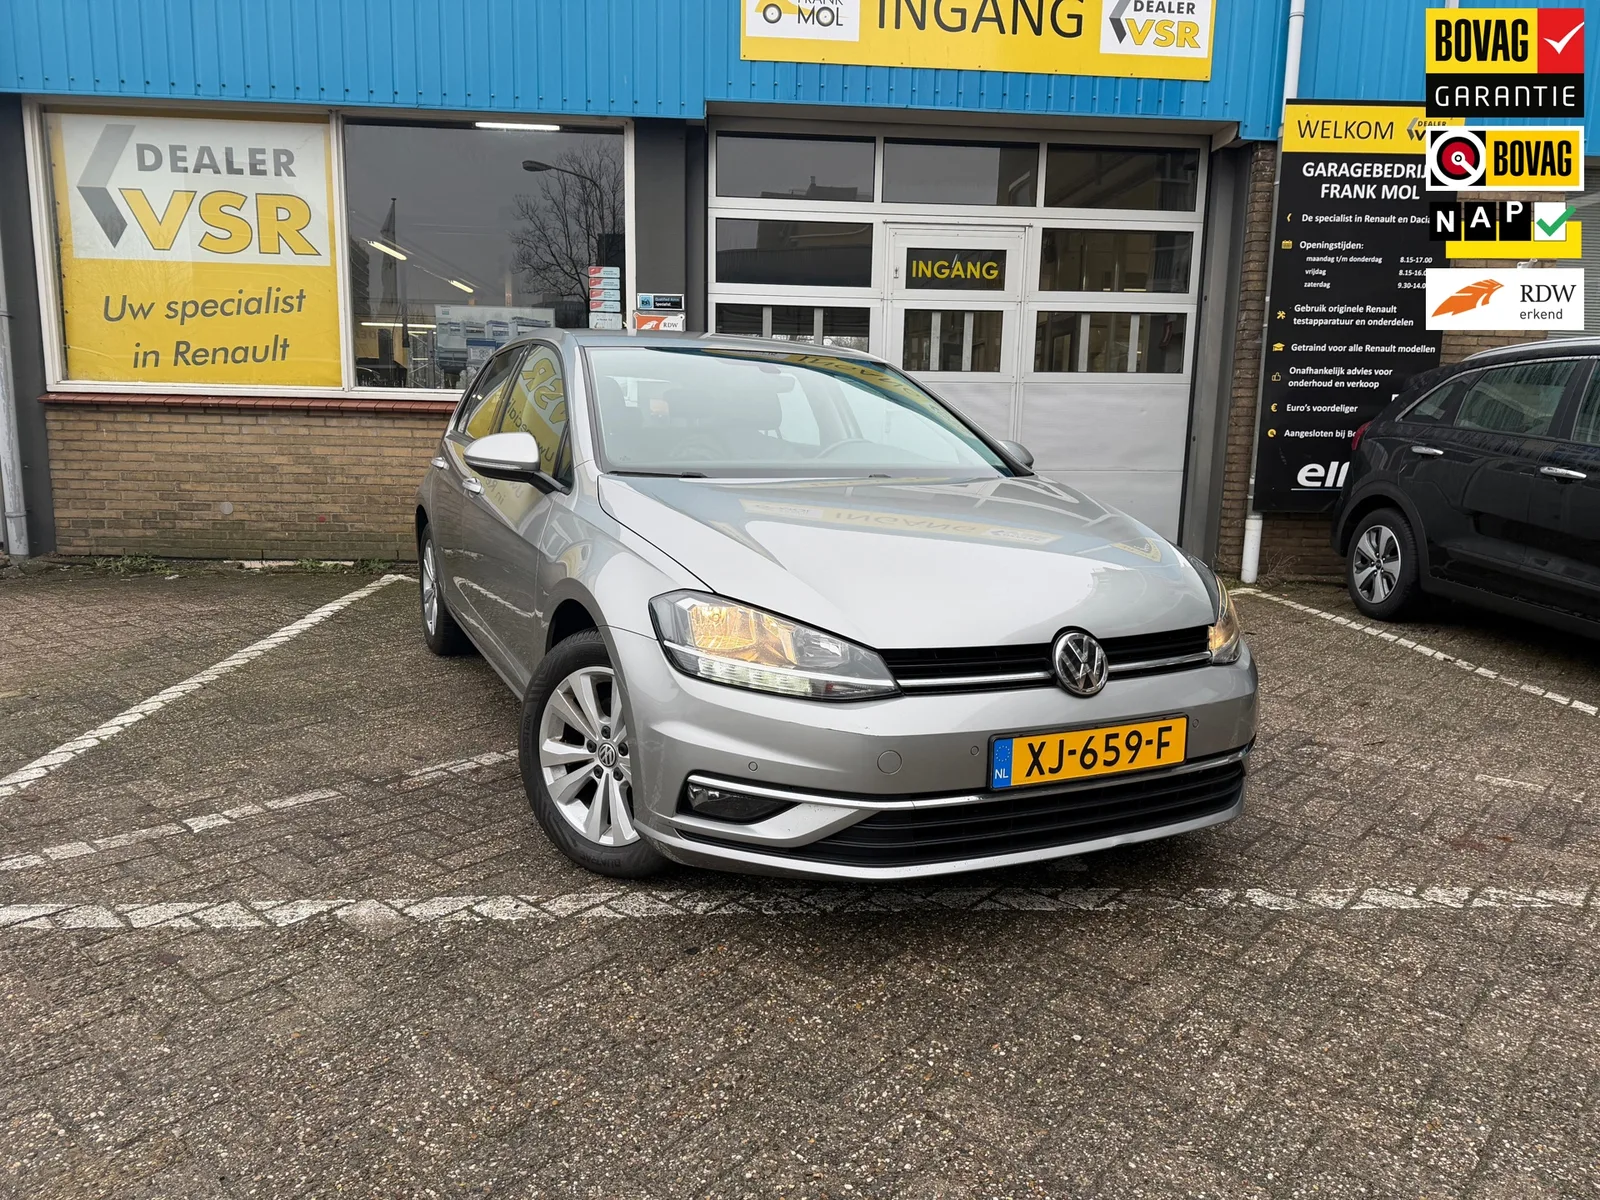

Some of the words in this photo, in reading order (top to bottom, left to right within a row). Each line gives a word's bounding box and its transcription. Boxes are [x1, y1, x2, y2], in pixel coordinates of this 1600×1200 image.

[1133, 0, 1196, 15] DEALER
[798, 5, 844, 27] MOL
[878, 0, 1084, 38] INGANG
[1124, 17, 1201, 48] VSR
[1297, 120, 1395, 141] WELKOM
[136, 143, 297, 178] DEALER
[1302, 162, 1426, 179] GARAGEBEDRIJ
[1320, 184, 1377, 200] FRANK
[1381, 185, 1420, 200] MOL
[118, 187, 322, 256] VSR
[1302, 214, 1313, 223] De
[1315, 214, 1353, 224] specialist
[1354, 215, 1363, 224] in
[1364, 214, 1396, 224] Renault
[1398, 216, 1408, 224] en
[1300, 240, 1364, 251] Openingstijden:
[1306, 255, 1334, 264] maandag
[1336, 255, 1348, 263] t/m
[1349, 255, 1383, 264] donderdag
[1400, 256, 1433, 264] 8.15-17.00
[912, 260, 999, 279] INGANG
[1305, 268, 1327, 277] vrijdag
[1304, 280, 1331, 289] zaterdag
[103, 295, 156, 322] Uw
[165, 286, 307, 325] specialist
[1294, 304, 1327, 313] Gebruik
[1328, 304, 1364, 315] originele
[1366, 304, 1397, 314] Renault
[1293, 317, 1354, 326] testapparatuur
[1367, 318, 1414, 327] onderdelen
[133, 342, 160, 368] in
[173, 334, 290, 367] Renault
[1291, 343, 1327, 352] Getraind
[1348, 343, 1363, 352] alle
[1365, 344, 1396, 353] Renault
[1398, 344, 1436, 354] modellen
[1289, 366, 1345, 376] Onafhankelijk
[1346, 368, 1372, 376] advies
[1288, 379, 1333, 388] onderhoud
[1346, 380, 1379, 389] verkoop
[1286, 403, 1311, 412] Euro's
[1312, 404, 1358, 414] voordeliger
[1284, 429, 1333, 439] Aangesloten
[1335, 430, 1346, 438] bij
[1025, 725, 1173, 778] XJ-659-F
[995, 768, 1009, 780] NL
